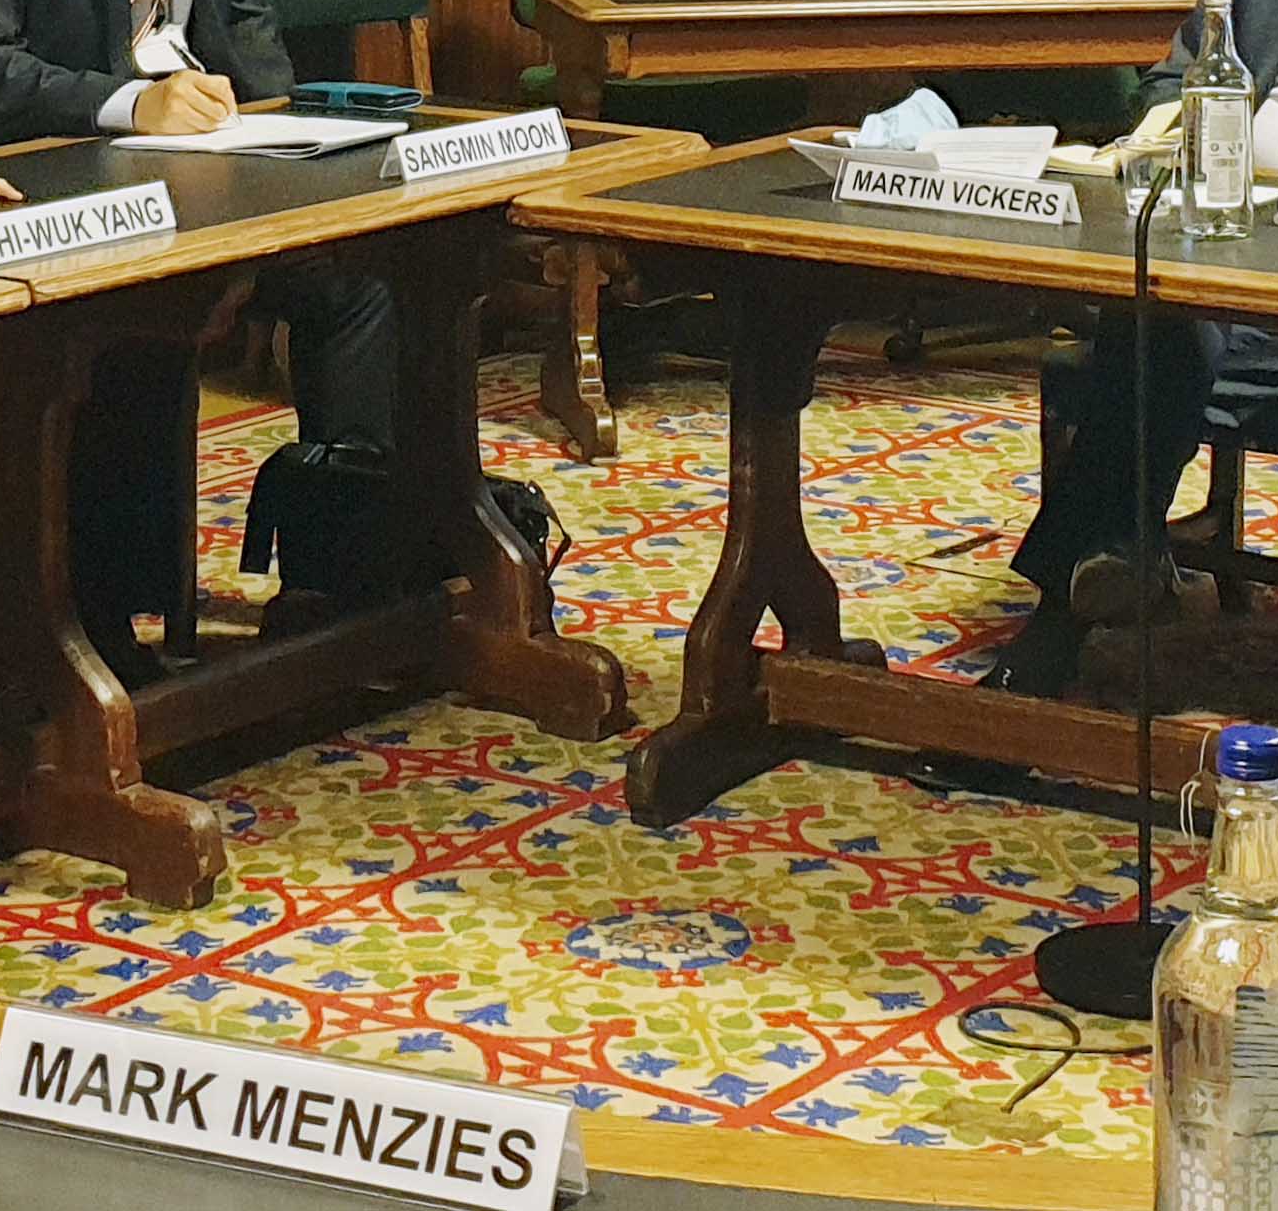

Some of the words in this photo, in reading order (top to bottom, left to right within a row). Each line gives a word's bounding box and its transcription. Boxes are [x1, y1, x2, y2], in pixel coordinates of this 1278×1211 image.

[405, 132, 497, 172] SANGMIN
[497, 122, 558, 155] MOON
[92, 196, 164, 236] YANG
[852, 169, 945, 201] MARTIN
[952, 181, 1060, 216] VICKERS
[18, 1042, 218, 1130] MARK
[231, 1079, 537, 1189] MENZIES
